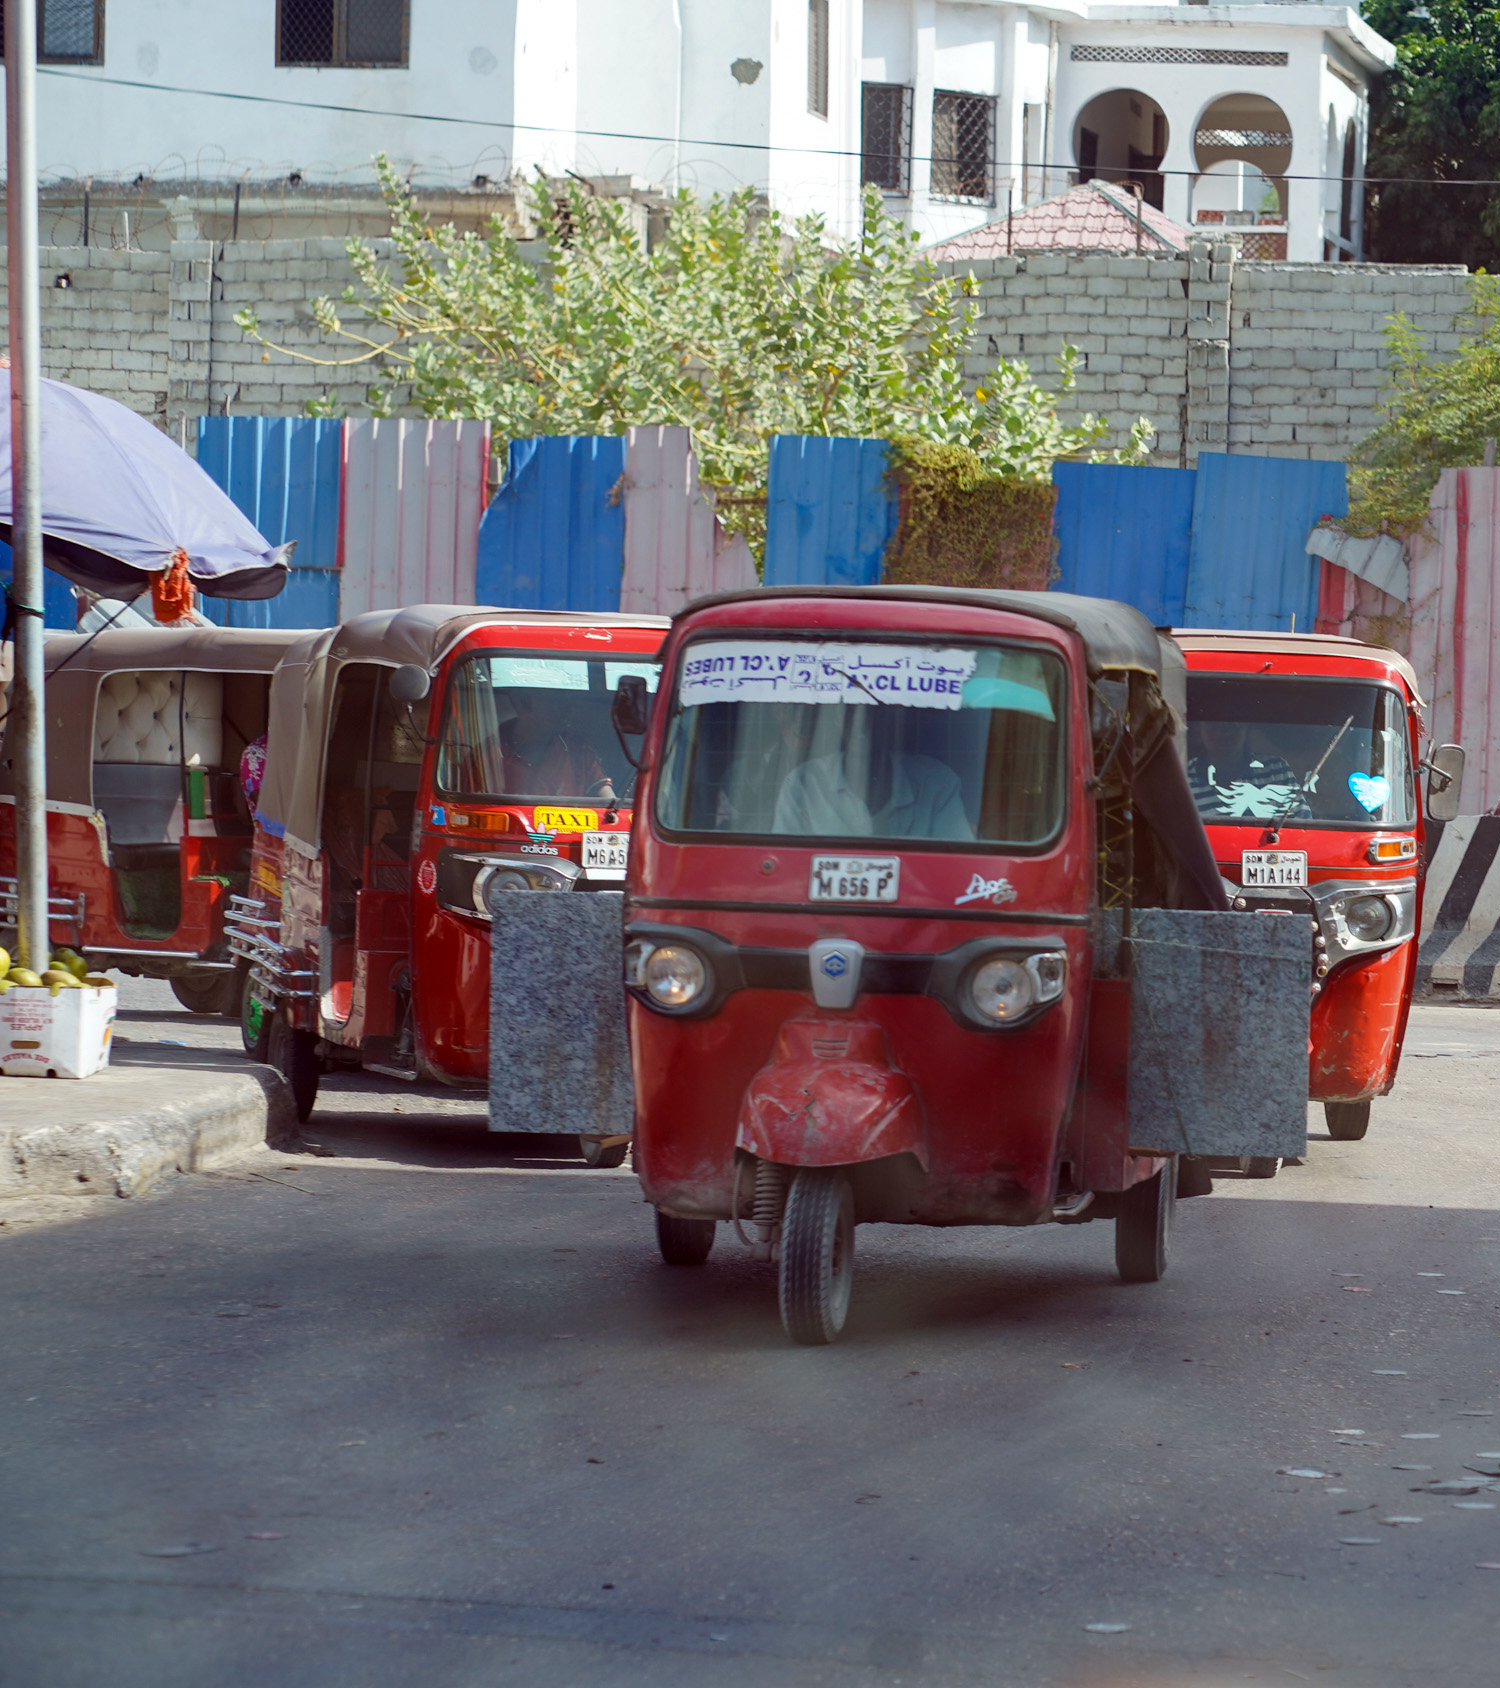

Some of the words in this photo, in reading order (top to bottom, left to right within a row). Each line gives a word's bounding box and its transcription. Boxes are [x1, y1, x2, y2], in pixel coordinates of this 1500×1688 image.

[541, 812, 592, 827] TAXI
[520, 843, 559, 856] adidas
[817, 860, 840, 871] SOM
[1246, 855, 1263, 863] SOM
[1247, 867, 1301, 884] M1A144
[818, 877, 832, 896] M
[838, 877, 869, 897] 656
[877, 878, 888, 897] P
